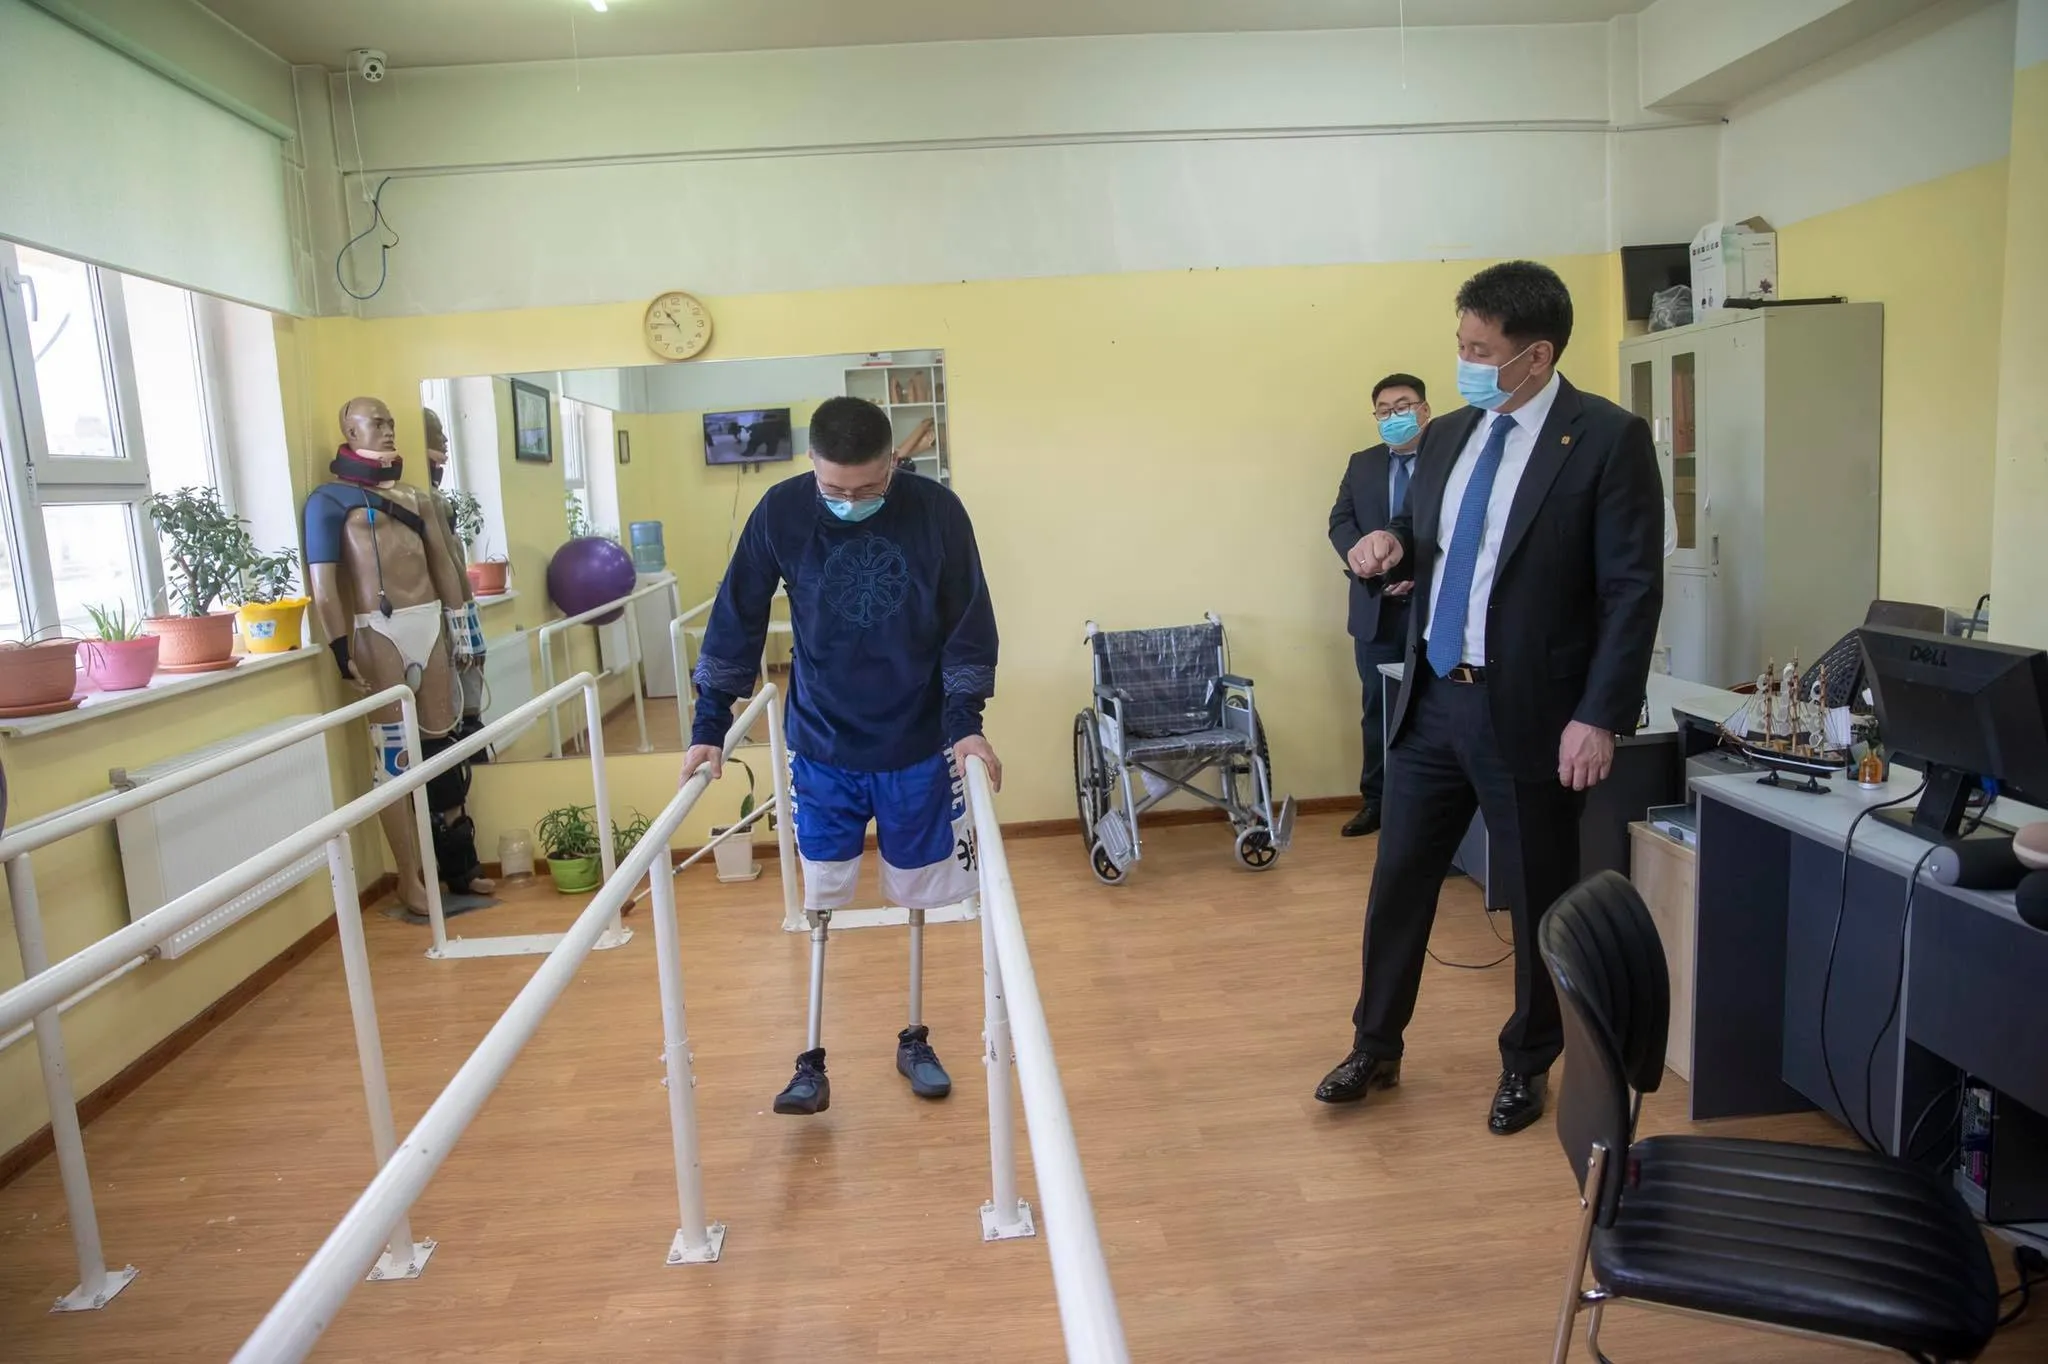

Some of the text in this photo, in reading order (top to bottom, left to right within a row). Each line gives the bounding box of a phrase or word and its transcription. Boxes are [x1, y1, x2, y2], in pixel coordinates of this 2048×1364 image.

[670, 297, 680, 305] 12
[692, 307, 700, 316] 2
[696, 319, 705, 328] 3
[664, 343, 670, 351] 7
[687, 340, 695, 350] 5
[1910, 645, 1948, 667] DELL
